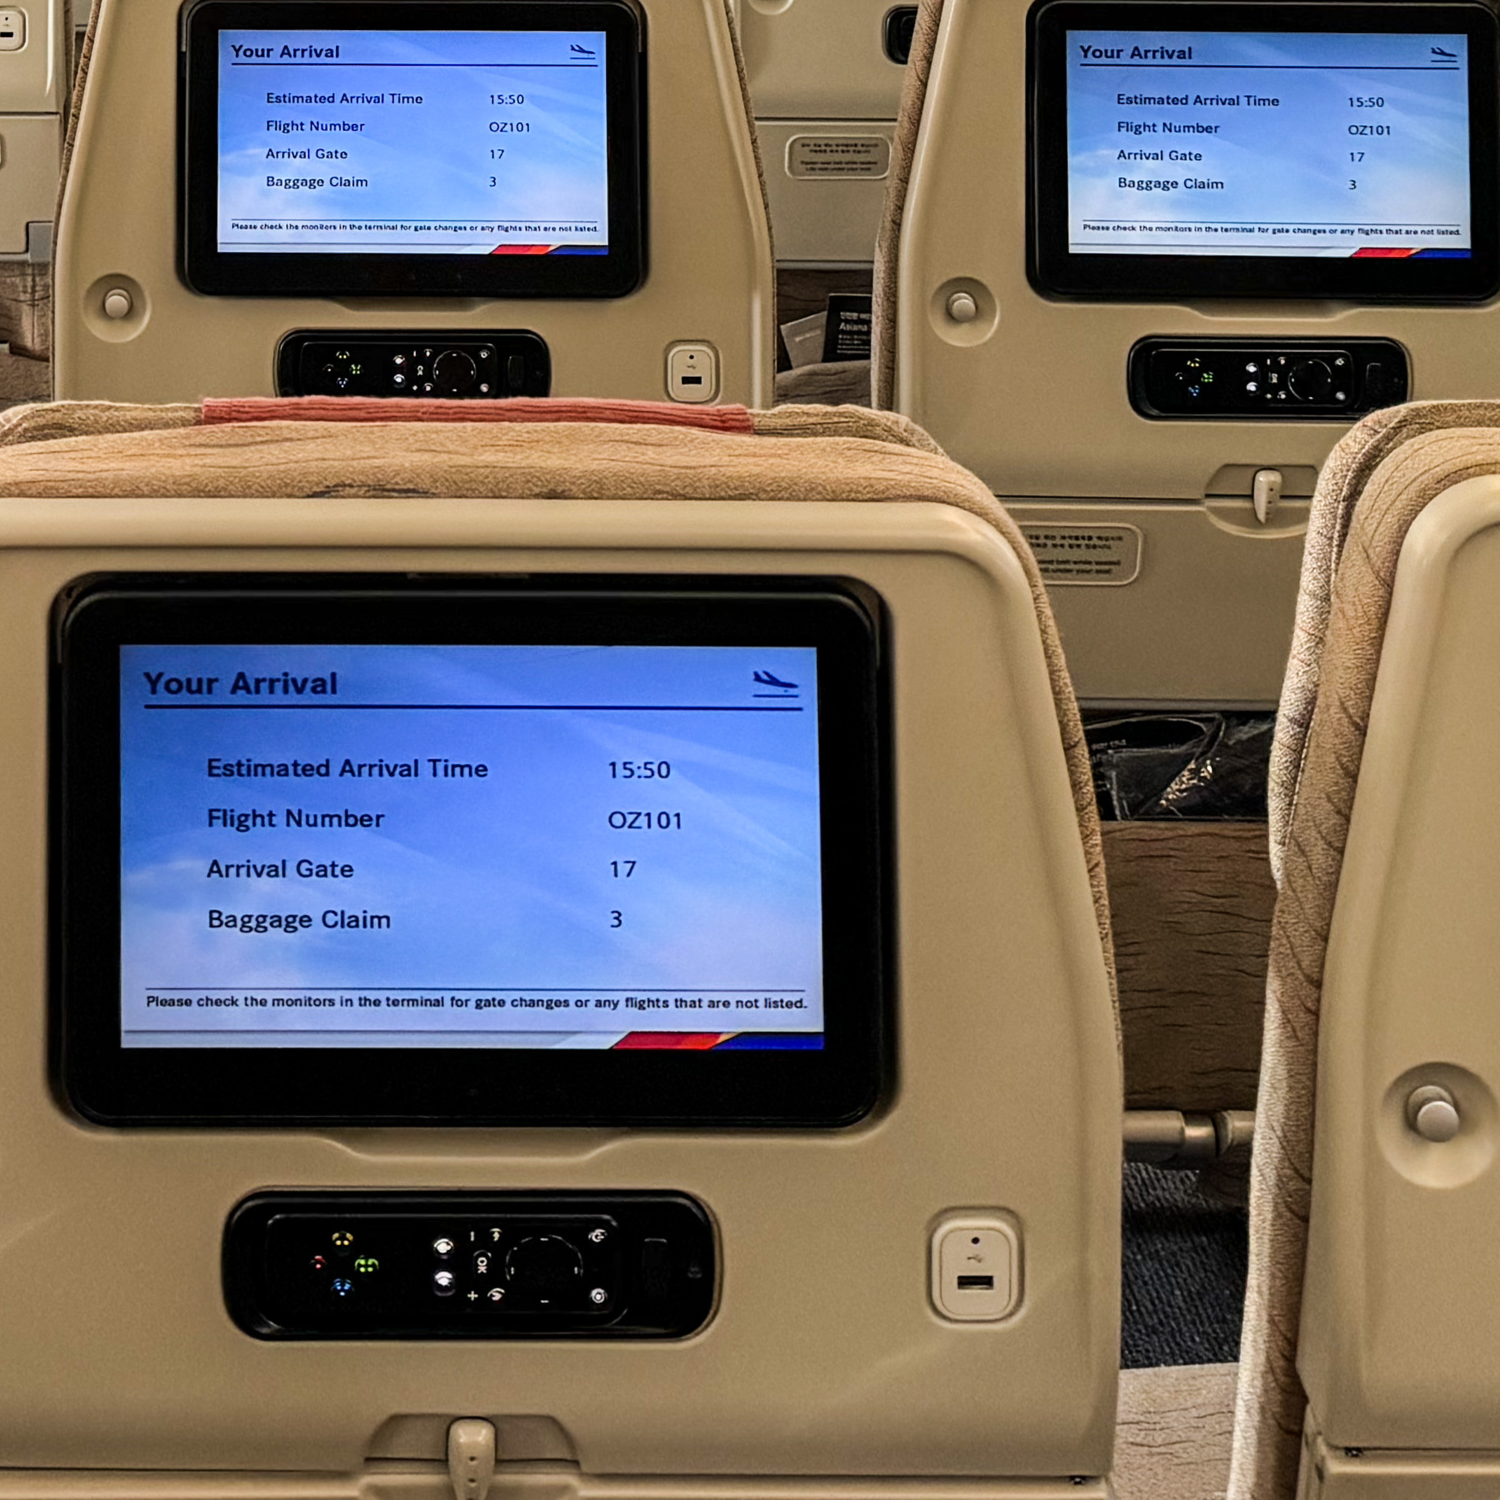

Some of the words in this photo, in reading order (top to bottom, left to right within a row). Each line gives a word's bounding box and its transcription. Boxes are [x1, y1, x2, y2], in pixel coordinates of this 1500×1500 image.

[230, 44, 274, 58] Your
[279, 44, 340, 58] Arrival
[1078, 44, 1124, 59] Your
[1129, 45, 1192, 60] Arrival
[266, 92, 335, 104] Estimated
[339, 92, 384, 104] Arrival
[388, 92, 423, 104] Time
[490, 93, 524, 105] 15:50
[1116, 93, 1188, 105] Estimated
[1192, 94, 1240, 106] Arrival
[1243, 94, 1280, 106] Time
[1348, 96, 1384, 108] 15:50
[266, 119, 305, 134] Flight
[309, 120, 365, 132] Number
[488, 121, 530, 132] OZ101
[1117, 120, 1157, 135] Flight
[1162, 121, 1220, 134] Number
[1347, 124, 1390, 135] OZ101
[265, 147, 310, 159] Arrival
[315, 148, 348, 159] Gate
[490, 148, 504, 159] 17
[1116, 149, 1163, 161] Arrival
[1168, 149, 1202, 161] Gate
[1349, 151, 1365, 162] 17
[266, 175, 324, 189] Baggage
[329, 175, 368, 187] Claim
[489, 175, 496, 187] 3
[1118, 176, 1178, 191] Baggage
[1183, 178, 1224, 189] Claim
[1348, 179, 1356, 190] 3
[142, 671, 219, 695] Your
[229, 671, 337, 695] Arrival
[207, 757, 330, 778] Estimated
[338, 758, 418, 778] Arrival
[426, 758, 488, 778] Time
[608, 760, 670, 779] 15:50
[207, 808, 277, 833] Flight
[285, 807, 385, 828] Number
[608, 810, 680, 829] OZ101
[206, 858, 286, 878] Arrival
[296, 858, 354, 878] Gate
[610, 860, 636, 878] 17
[208, 909, 312, 933] Baggage
[321, 909, 390, 929] Claim
[610, 909, 622, 928] 3
[146, 995, 192, 1007] Please
[196, 995, 239, 1007] check
[244, 995, 268, 1007] the
[271, 995, 335, 1007] monitors
[340, 995, 353, 1007] in
[358, 995, 382, 1007] the
[385, 995, 444, 1007] terminal
[450, 995, 471, 1007] for
[474, 996, 506, 1010] gate
[510, 996, 570, 1010] changes
[574, 998, 590, 1008] or
[594, 999, 620, 1011] any
[624, 996, 669, 1010] flights
[674, 997, 703, 1009] that
[706, 999, 731, 1008] are
[735, 998, 760, 1009] not
[763, 997, 808, 1009] listed.
[478, 1257, 488, 1274] OK
